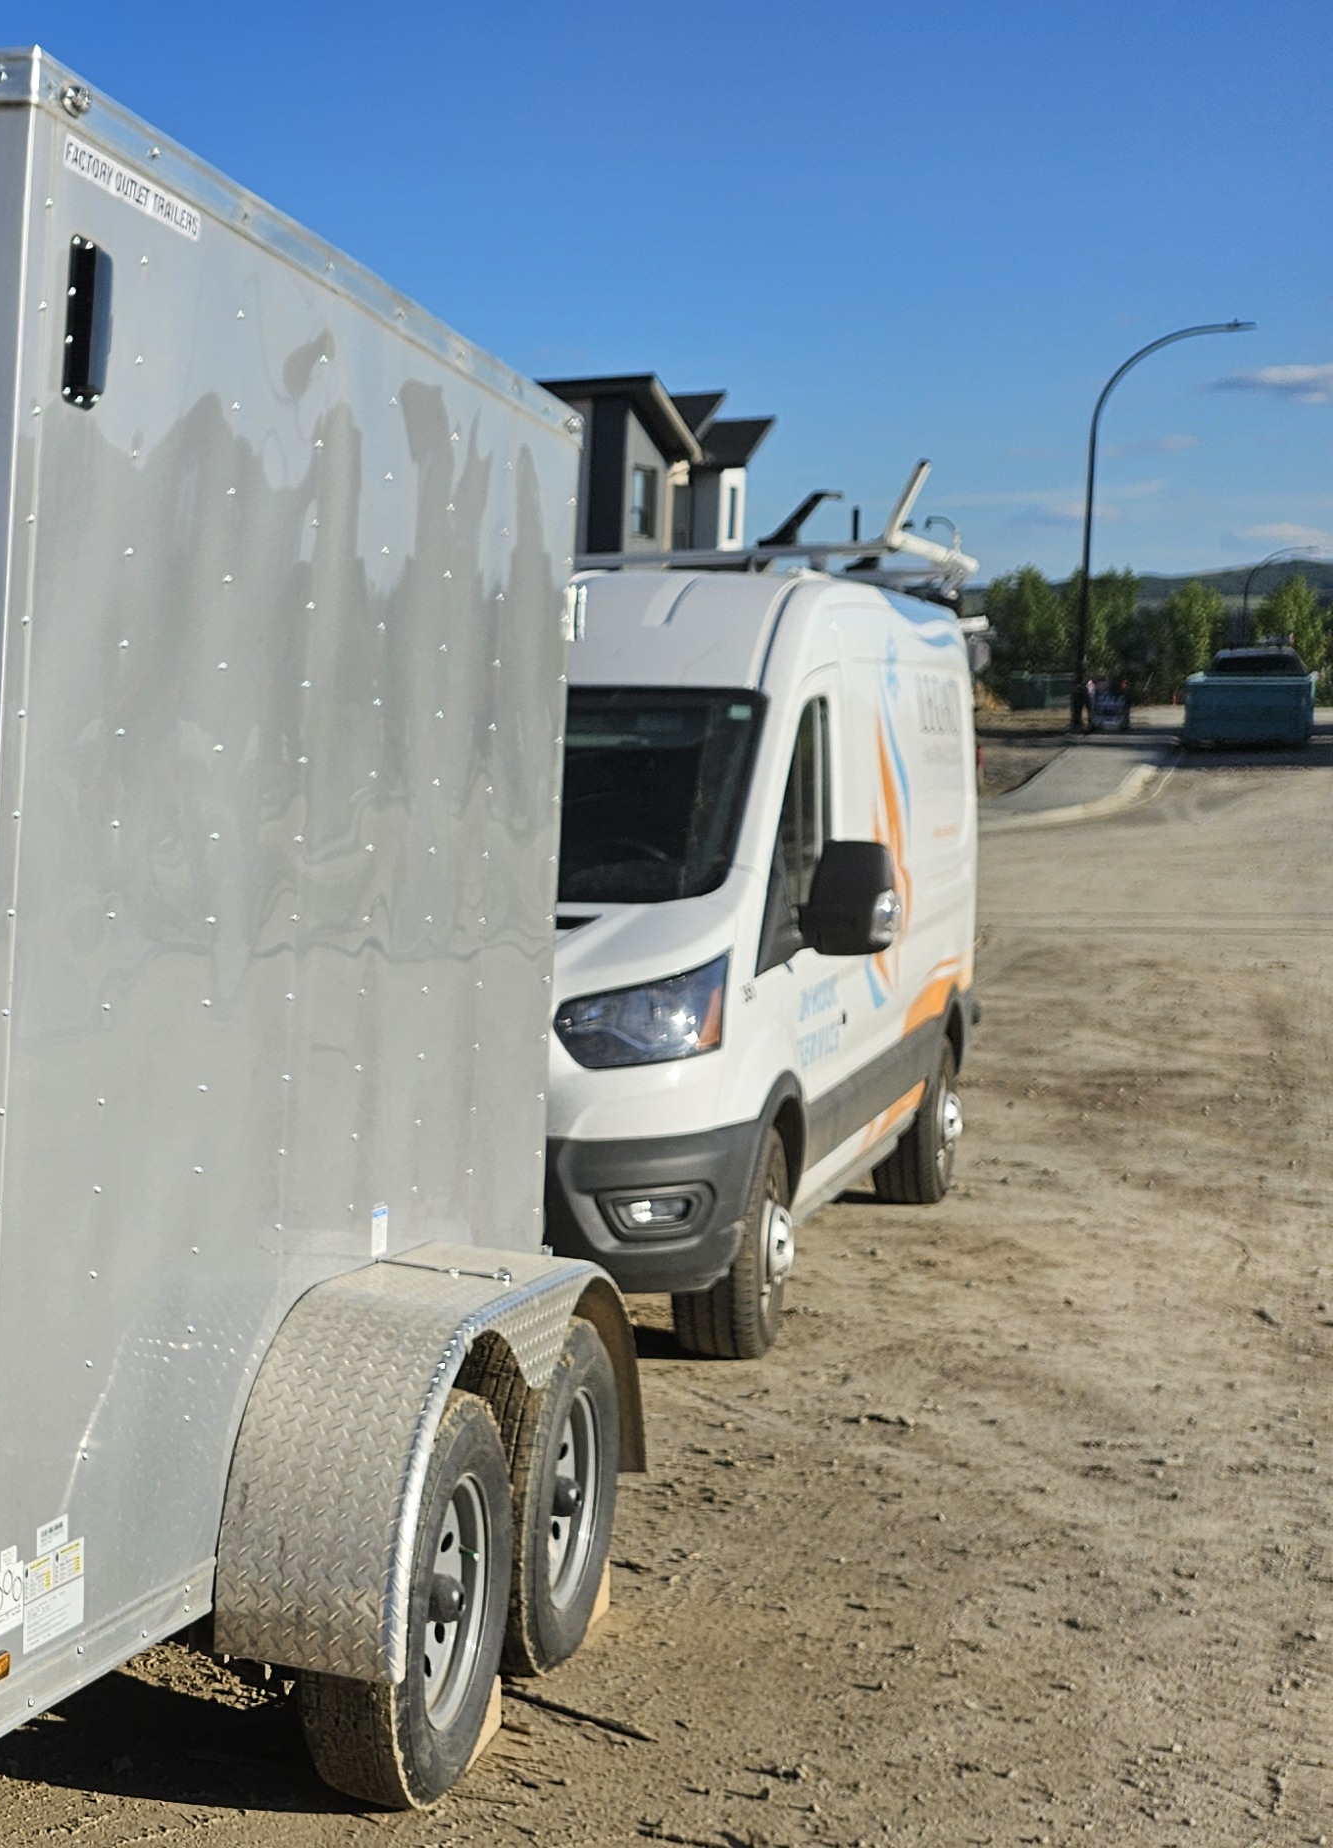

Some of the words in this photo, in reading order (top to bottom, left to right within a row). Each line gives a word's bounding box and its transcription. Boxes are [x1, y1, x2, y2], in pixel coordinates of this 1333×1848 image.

[65, 142, 114, 185] FACTORY
[114, 171, 151, 206] OUTLET
[153, 193, 199, 236] TRAILERS
